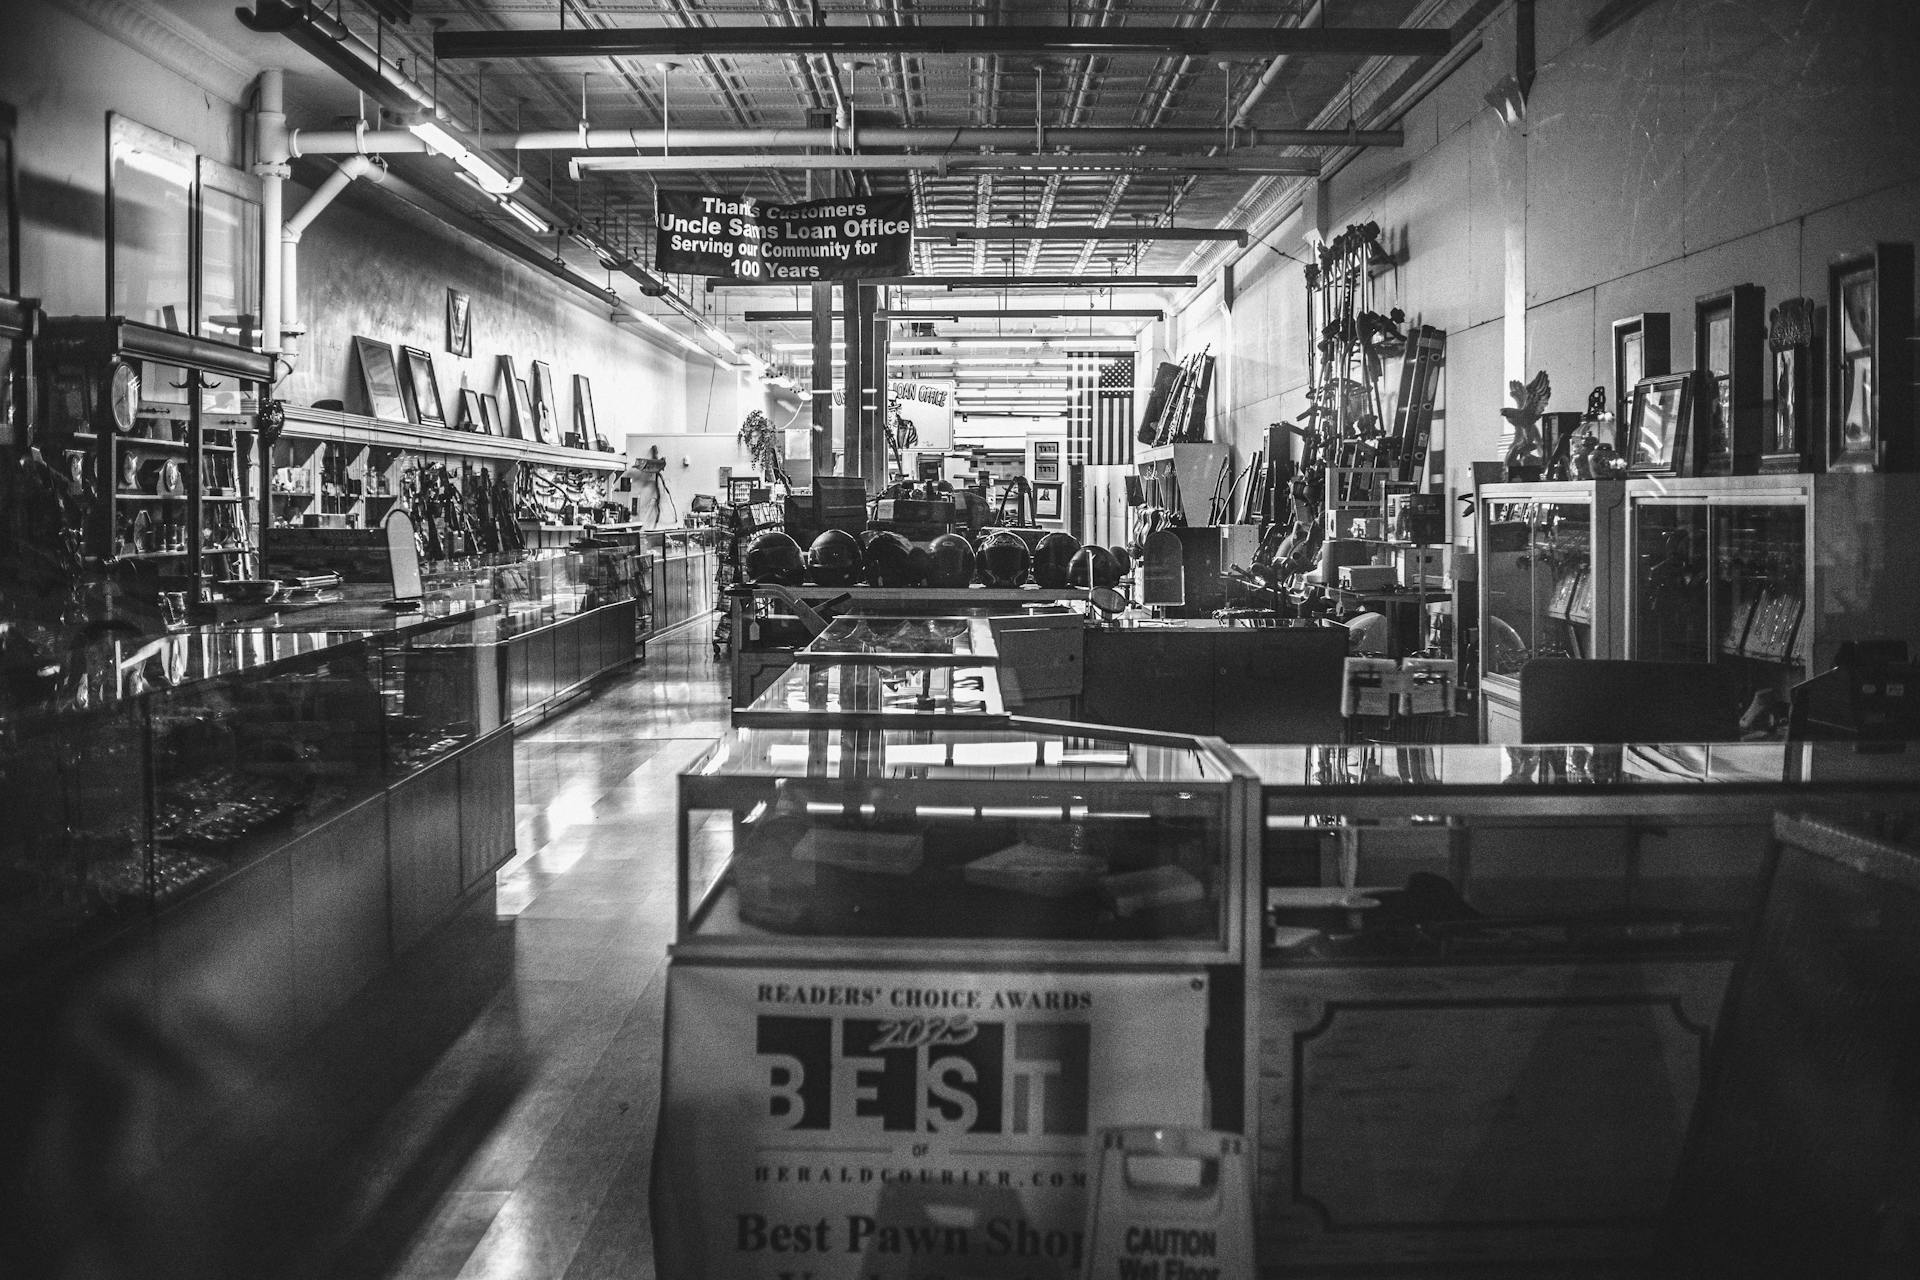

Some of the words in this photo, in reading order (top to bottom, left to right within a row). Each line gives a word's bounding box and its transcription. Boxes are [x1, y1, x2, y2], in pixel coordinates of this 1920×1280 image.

[766, 204, 867, 219] Customers
[660, 213, 722, 235] Uncle
[728, 218, 779, 239] Sams
[785, 221, 837, 239] Loan
[843, 218, 910, 238] Office
[671, 235, 734, 258] Serving
[738, 243, 758, 257] our
[761, 241, 851, 260] Community
[854, 240, 878, 256] for
[731, 259, 760, 277] 100
[765, 262, 820, 278] Years
[918, 384, 948, 407] OFFICE
[758, 984, 882, 1007] READERS'
[890, 988, 980, 1008] CHOICE
[991, 990, 1091, 1010] AWARDS
[756, 1053, 1062, 1134] BEST
[911, 1143, 929, 1158] OF
[754, 1165, 1088, 1189] HERALDCOURIER.COM
[736, 1213, 831, 1254] Best
[847, 1214, 969, 1254] Pawn
[1125, 1226, 1217, 1257] CAUTION
